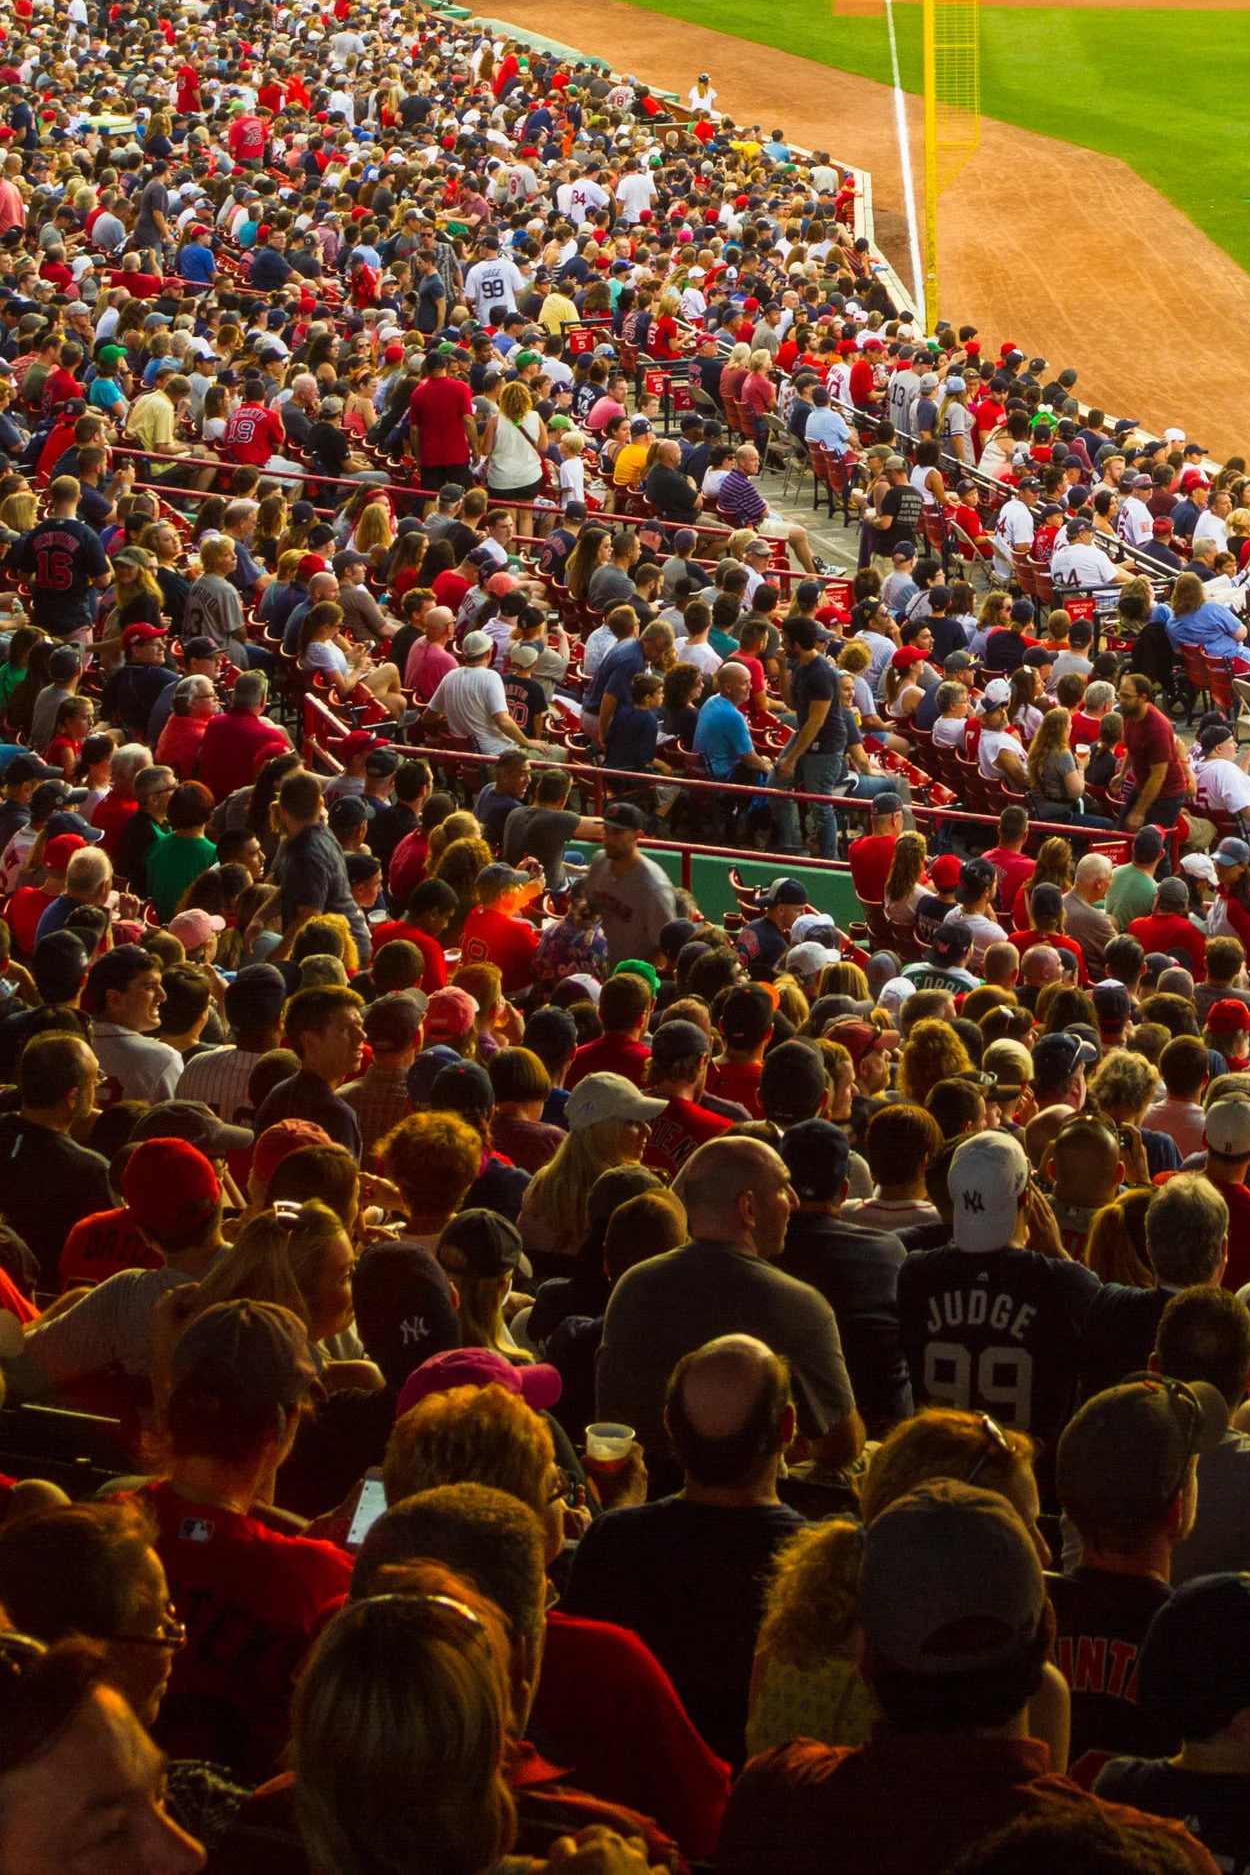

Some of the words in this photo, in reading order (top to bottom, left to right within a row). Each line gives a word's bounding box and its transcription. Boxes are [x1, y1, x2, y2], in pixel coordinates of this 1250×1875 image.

[573, 190, 587, 206] 34
[481, 279, 504, 299] 99
[577, 340, 586, 349] 5
[654, 382, 663, 392] 5
[891, 383, 905, 406] 13
[228, 419, 255, 444] 19
[37, 550, 73, 591] 16
[962, 1190, 985, 1214] NY
[926, 1289, 1037, 1341] JUDGE
[399, 1314, 429, 1346] NY
[924, 1341, 1034, 1430] 99
